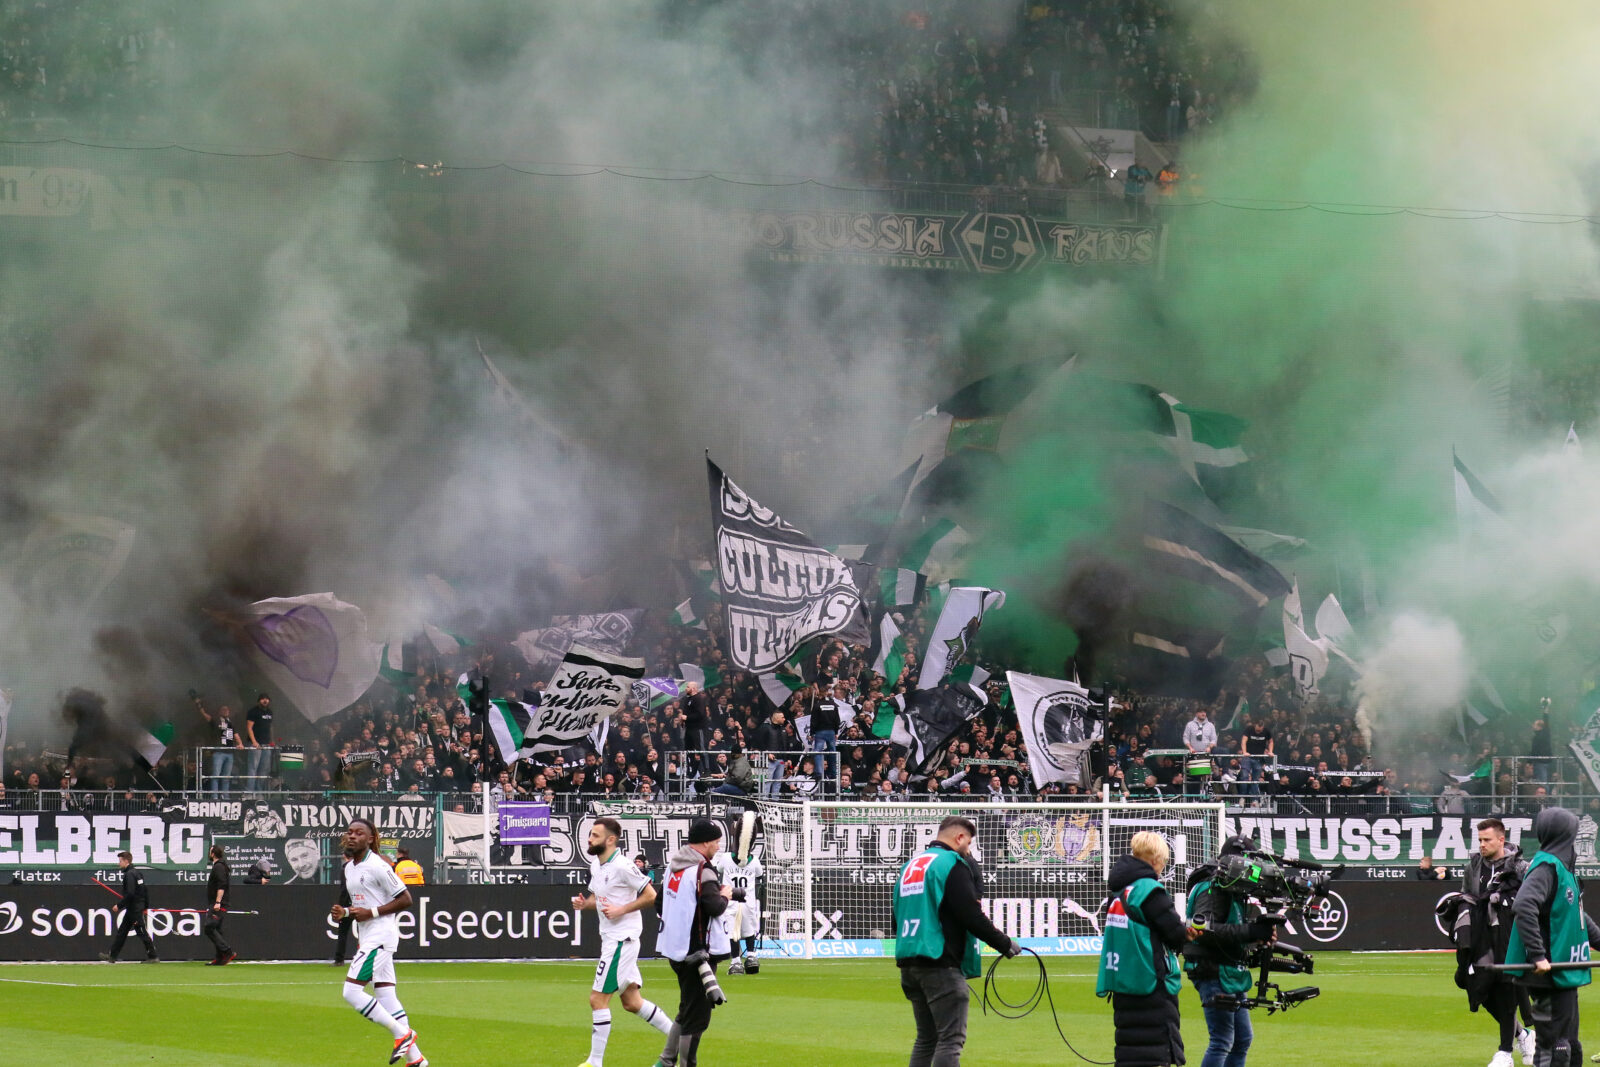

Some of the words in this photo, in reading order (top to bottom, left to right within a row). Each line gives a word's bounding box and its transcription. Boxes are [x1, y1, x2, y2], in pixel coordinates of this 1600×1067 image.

[750, 211, 945, 259] ORUSSIA
[1050, 225, 1157, 264] FANS
[188, 802, 242, 818] BANDA
[282, 804, 435, 830] FRONTLINE
[401, 829, 433, 840] 2006
[13, 870, 62, 882] flatex
[95, 870, 125, 882] flat
[1031, 868, 1087, 883] flatex
[1365, 867, 1406, 879] flatex
[1575, 868, 1600, 879] atex
[731, 876, 748, 888] 10
[901, 918, 921, 939] 07
[1056, 939, 1102, 953] JONG
[597, 960, 606, 976] 9
[1105, 951, 1120, 972] 12
